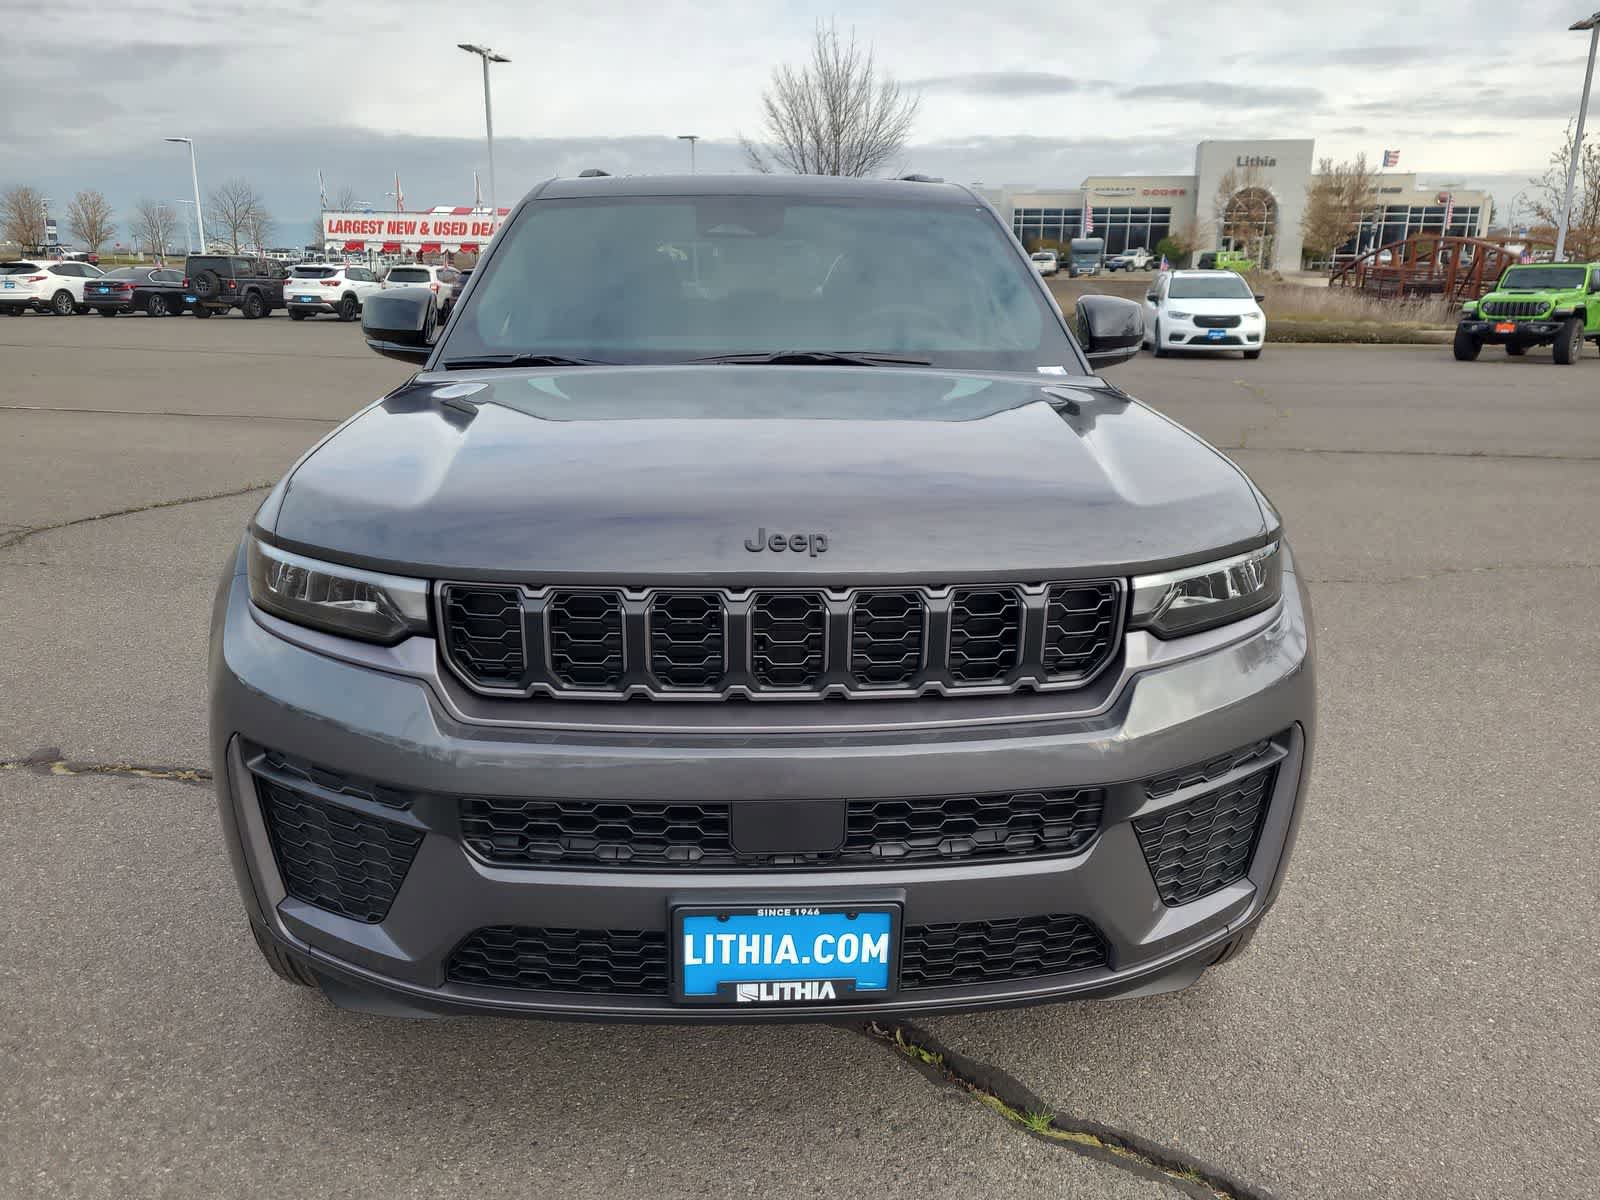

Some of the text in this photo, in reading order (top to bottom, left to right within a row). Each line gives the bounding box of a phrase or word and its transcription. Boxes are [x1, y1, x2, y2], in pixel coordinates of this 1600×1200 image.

[1236, 155, 1277, 168] Lithia
[327, 219, 384, 235] LARGEST
[387, 220, 417, 235] NEW
[419, 222, 430, 236] &
[433, 222, 468, 236] USED
[744, 527, 828, 558] Jeep
[757, 908, 820, 917] SINCE 1946
[684, 932, 889, 965] LITHIA.COM
[759, 981, 836, 1000] LITHIA
